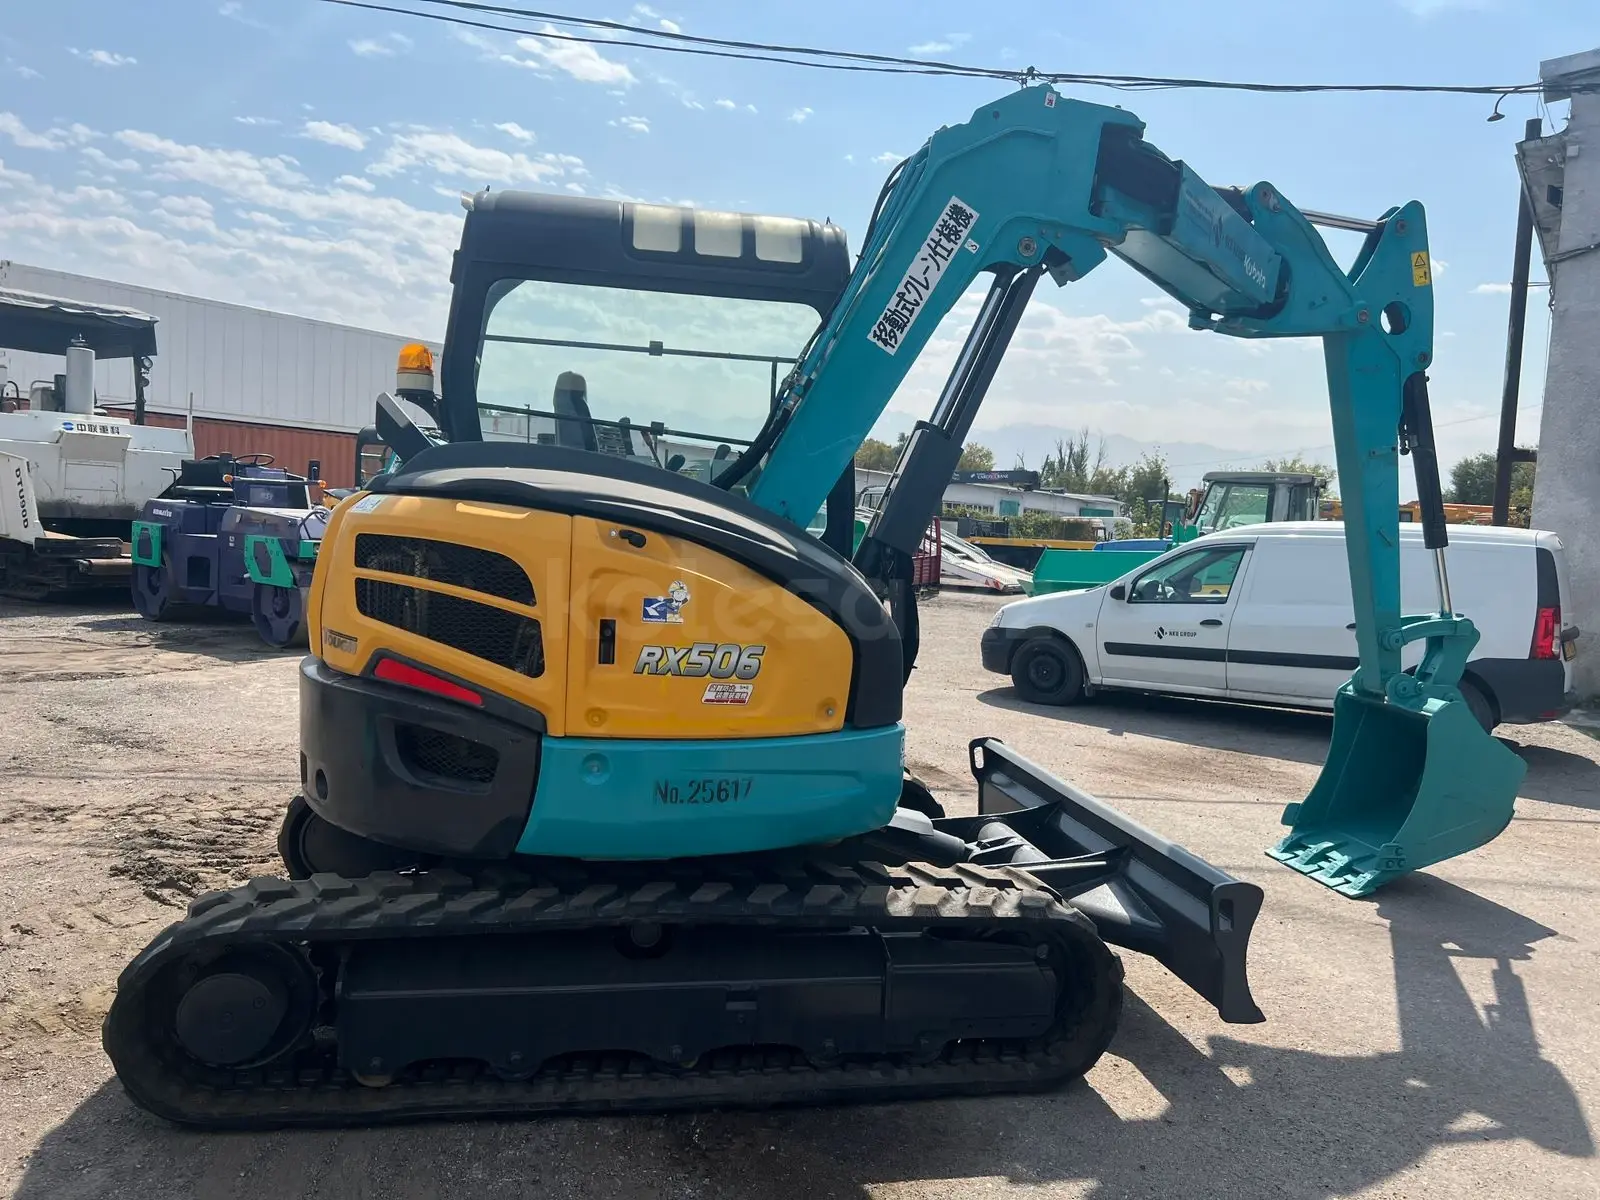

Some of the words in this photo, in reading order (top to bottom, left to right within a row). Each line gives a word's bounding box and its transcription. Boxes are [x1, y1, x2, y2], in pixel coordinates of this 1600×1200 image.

[872, 203, 974, 350] 移動式クレーン仕様機
[76, 422, 120, 435] 中联重科
[633, 642, 767, 681] RX506
